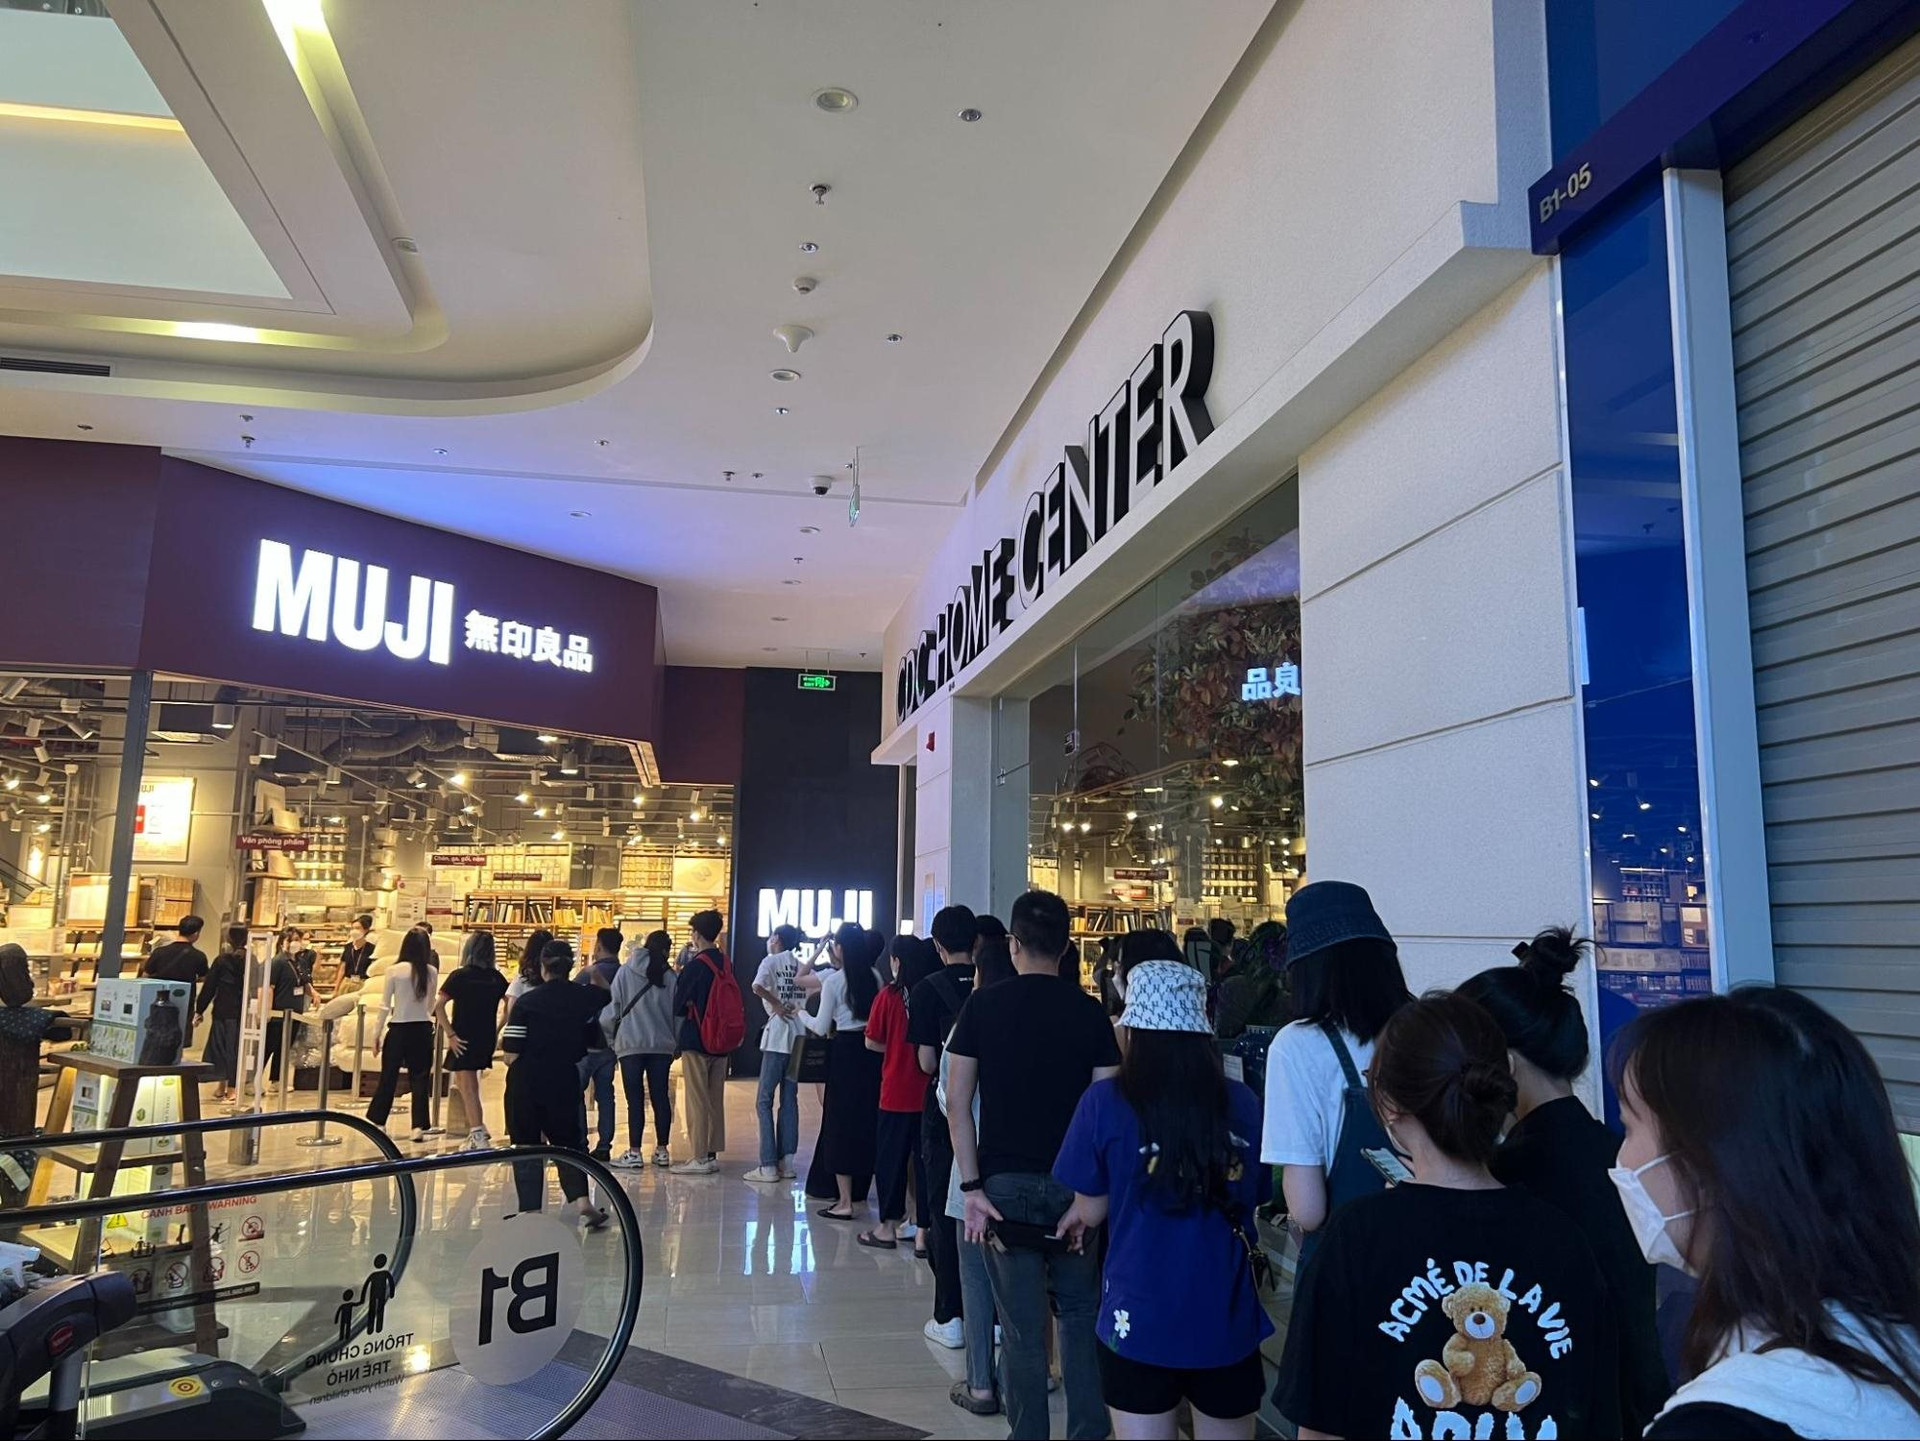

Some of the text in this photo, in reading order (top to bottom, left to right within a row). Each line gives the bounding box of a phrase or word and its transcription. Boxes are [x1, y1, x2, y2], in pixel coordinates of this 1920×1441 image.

[1538, 161, 1593, 224] B1-05
[936, 537, 1015, 683] HOME
[1017, 309, 1215, 611] CENTER
[251, 538, 456, 665] MUJI
[463, 609, 594, 673] 無印良品
[208, 1195, 257, 1210] WARNING
[1453, 1261, 1490, 1288] DE
[1537, 1301, 1573, 1360] VIE
